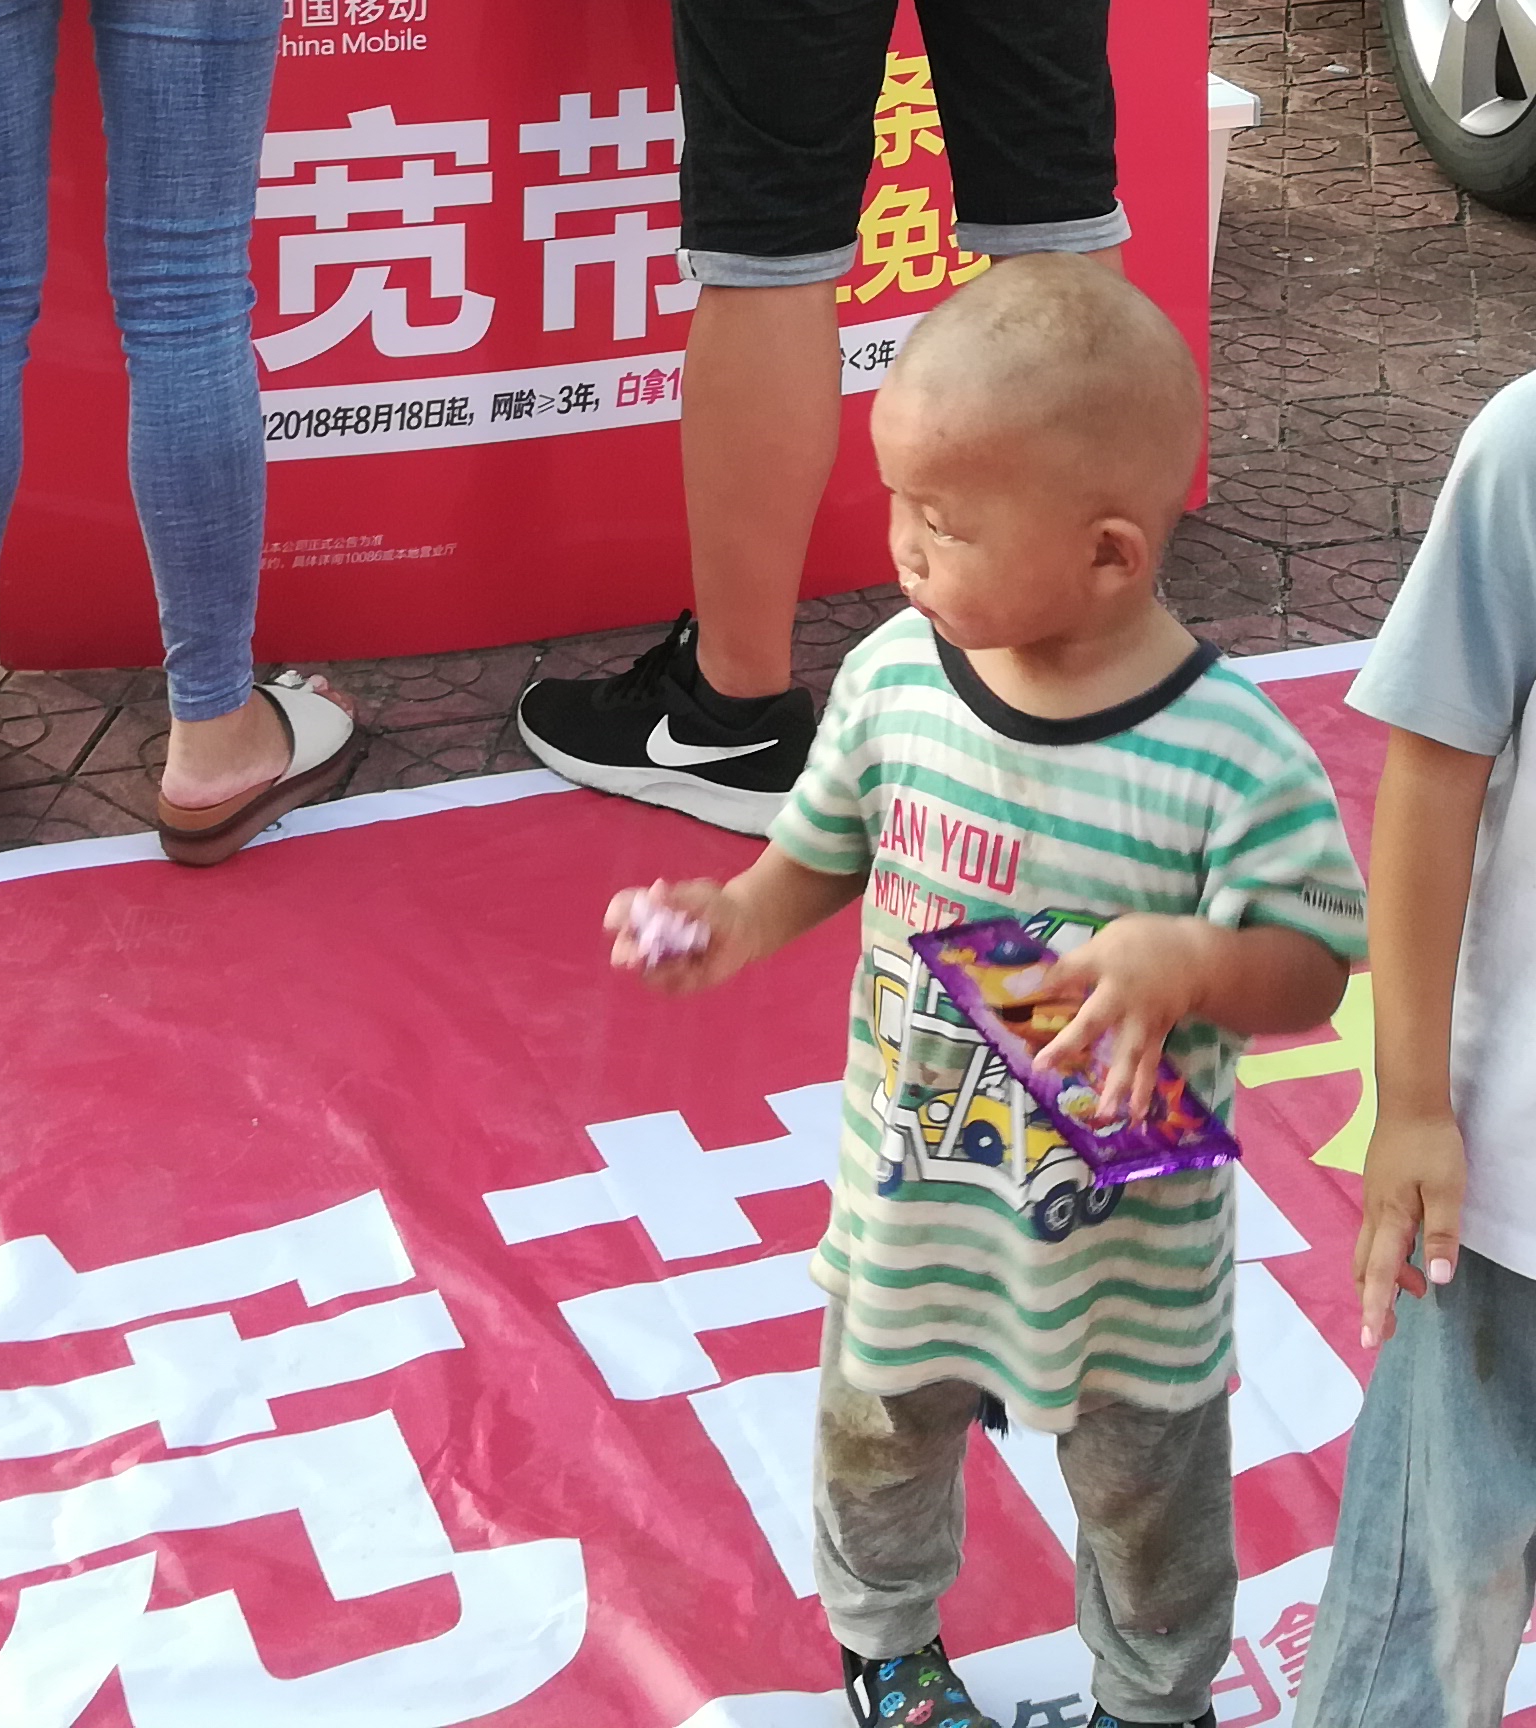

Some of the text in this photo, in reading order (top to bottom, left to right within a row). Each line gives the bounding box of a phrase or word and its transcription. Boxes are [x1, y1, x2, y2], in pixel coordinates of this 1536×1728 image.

[277, 28, 427, 57] hina Mobile
[254, 84, 702, 372] 宽带
[840, 339, 896, 371] <3年
[940, 813, 1021, 896] YOU
[874, 867, 967, 935] MOVE IT?
